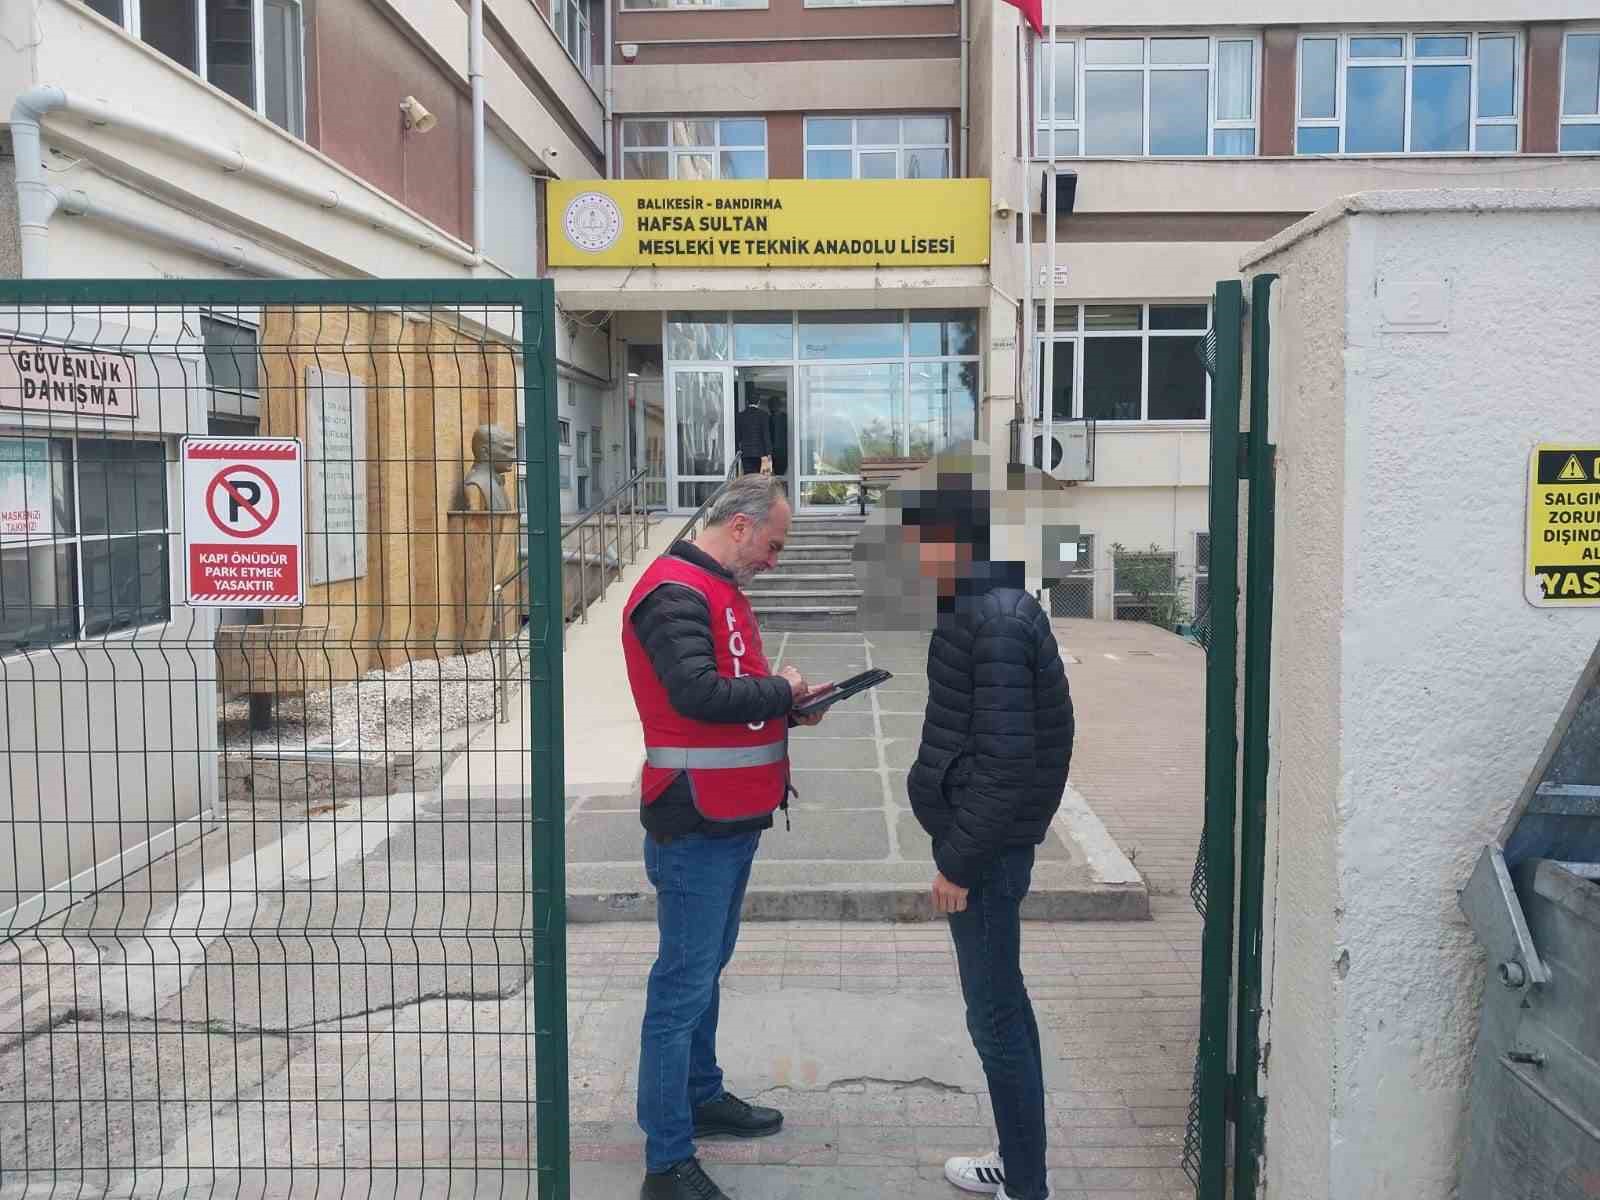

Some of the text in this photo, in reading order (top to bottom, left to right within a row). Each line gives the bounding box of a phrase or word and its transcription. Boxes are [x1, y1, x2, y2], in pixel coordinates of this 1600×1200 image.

[637, 196, 703, 209] BALIKESİR
[715, 198, 782, 209] BANDIRMA
[637, 216, 768, 231] HAFSA SULTAN
[639, 236, 955, 255] MESLEKİ VE TEKNİK ANADOLU LİSESİ
[18, 347, 121, 382] GÜVENLİK
[23, 378, 118, 409] DANIŞMA
[1549, 511, 1600, 524] ZORU
[199, 551, 288, 565] KAPI ÖNÜDÜR
[205, 567, 283, 578] PARK ETMEK
[214, 579, 275, 591] YASAKTIR
